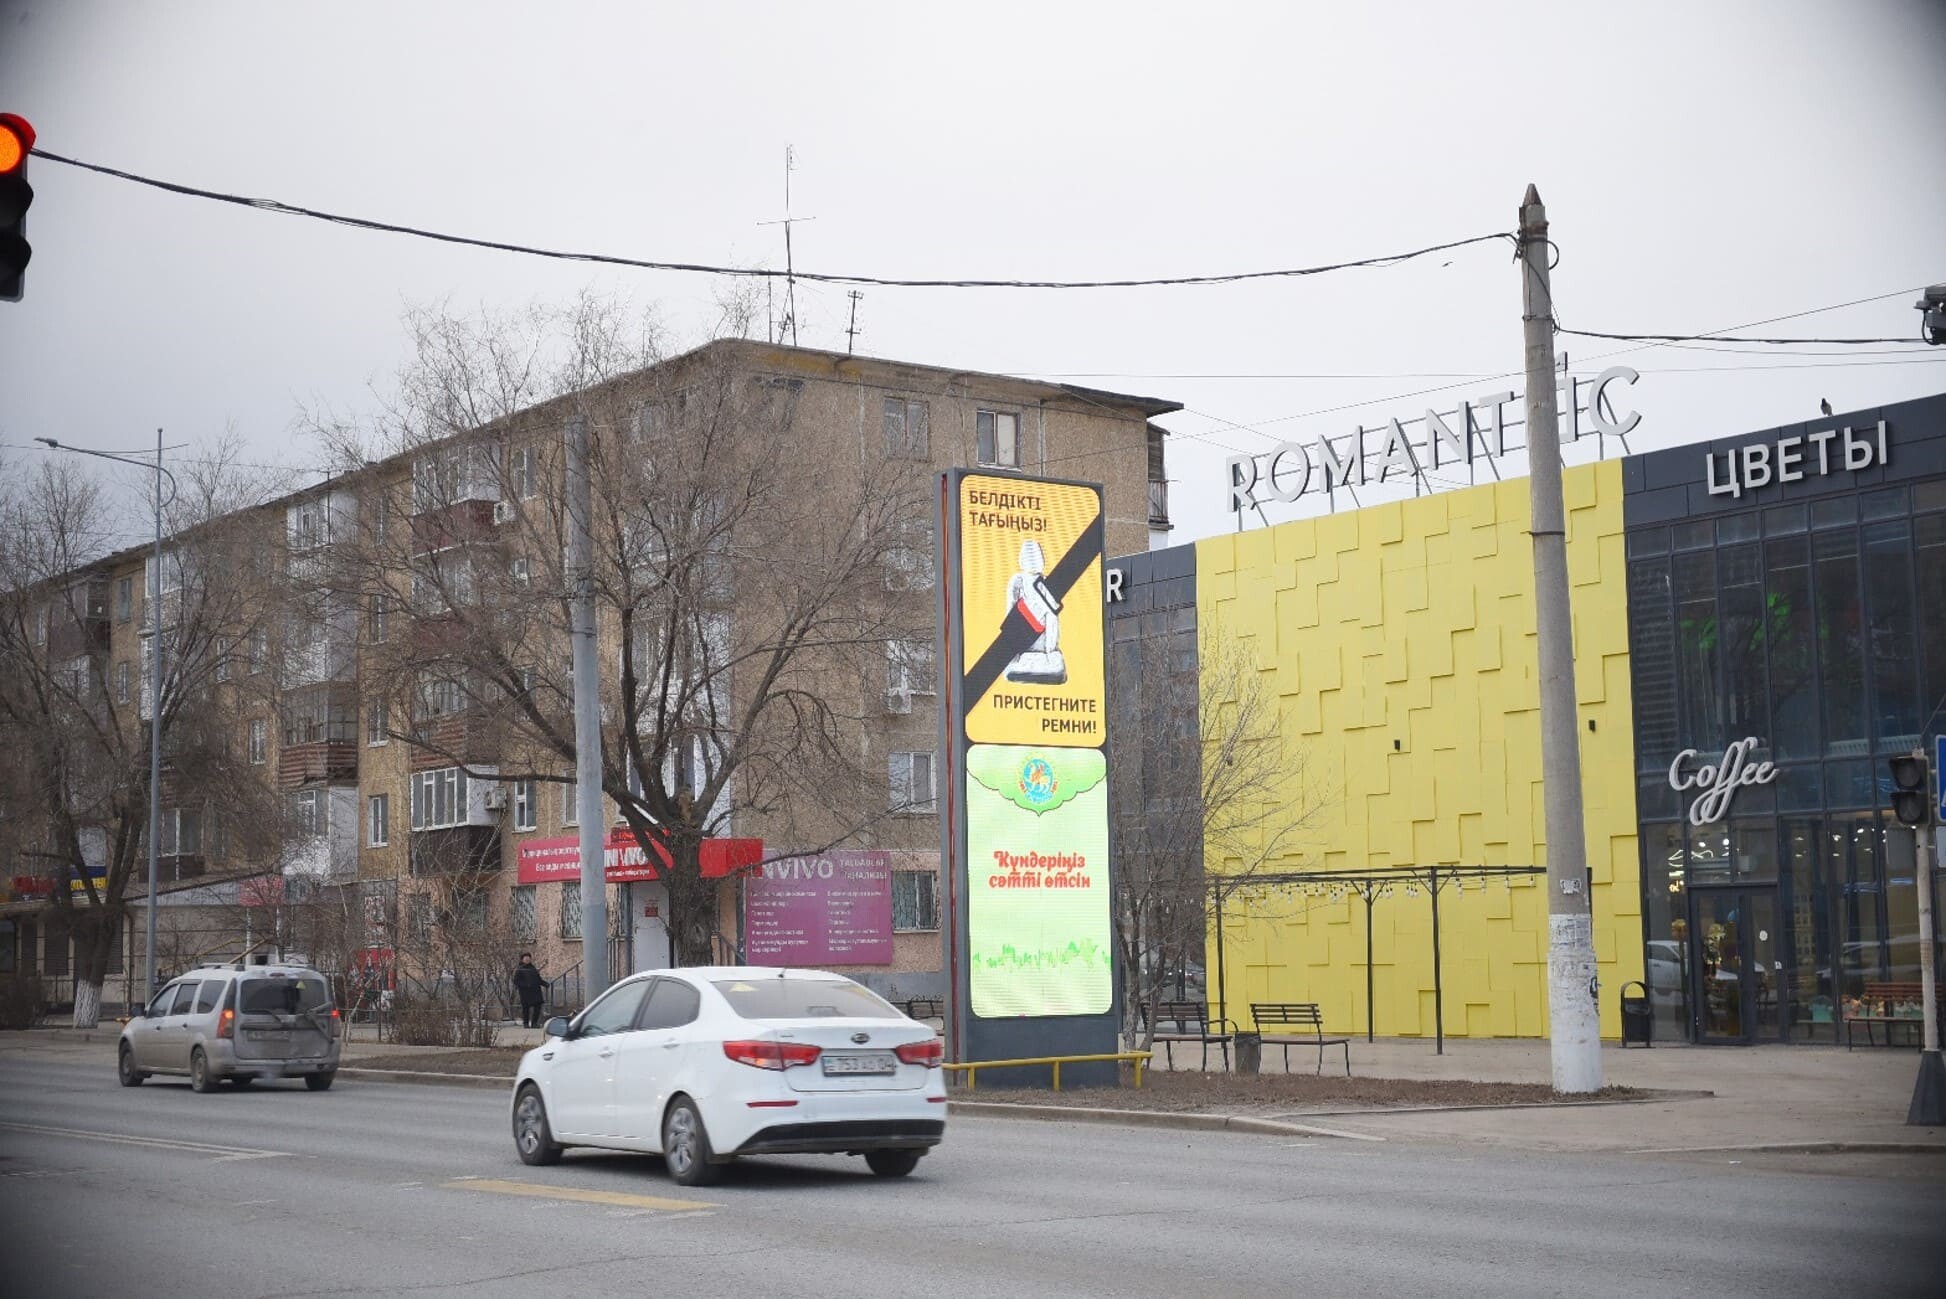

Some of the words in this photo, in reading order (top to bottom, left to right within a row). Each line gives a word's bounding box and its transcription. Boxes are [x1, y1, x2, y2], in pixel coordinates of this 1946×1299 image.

[1706, 420, 1887, 498] ЦВЕТЫ
[969, 490, 1041, 511] БЕЛДІКТІ
[969, 511, 1047, 532] ТАҒЫҢЫЗ!
[993, 694, 1096, 713] ПРИСТЕГНИТЕ
[1041, 718, 1096, 734] РЕМНИ!
[1669, 736, 1779, 825] Coffee
[993, 850, 1085, 872] Күндеріңіз
[989, 871, 1041, 888] сәтті
